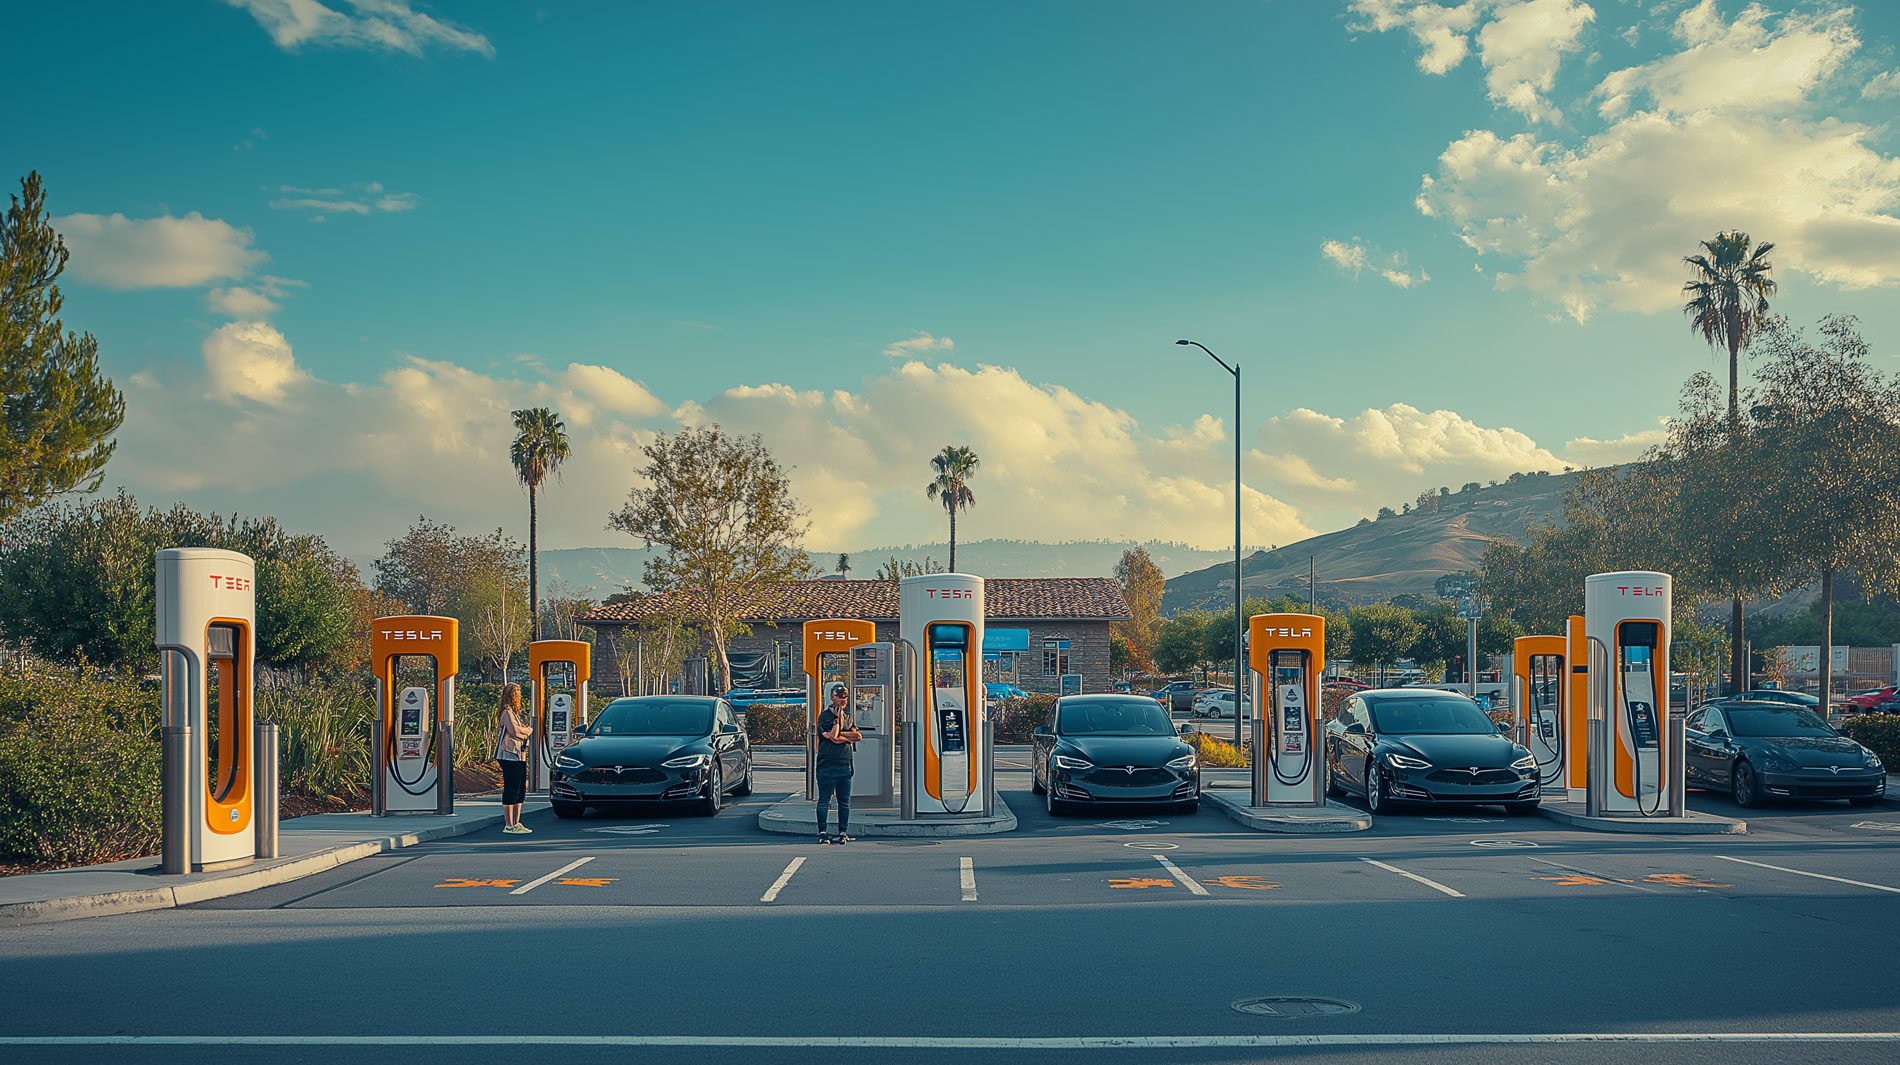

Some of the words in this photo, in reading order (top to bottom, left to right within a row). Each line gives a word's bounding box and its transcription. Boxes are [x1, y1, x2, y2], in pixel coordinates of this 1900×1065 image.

[381, 630, 441, 640] TESLA
[813, 631, 859, 641] TESL
[1265, 628, 1311, 638] TELA
